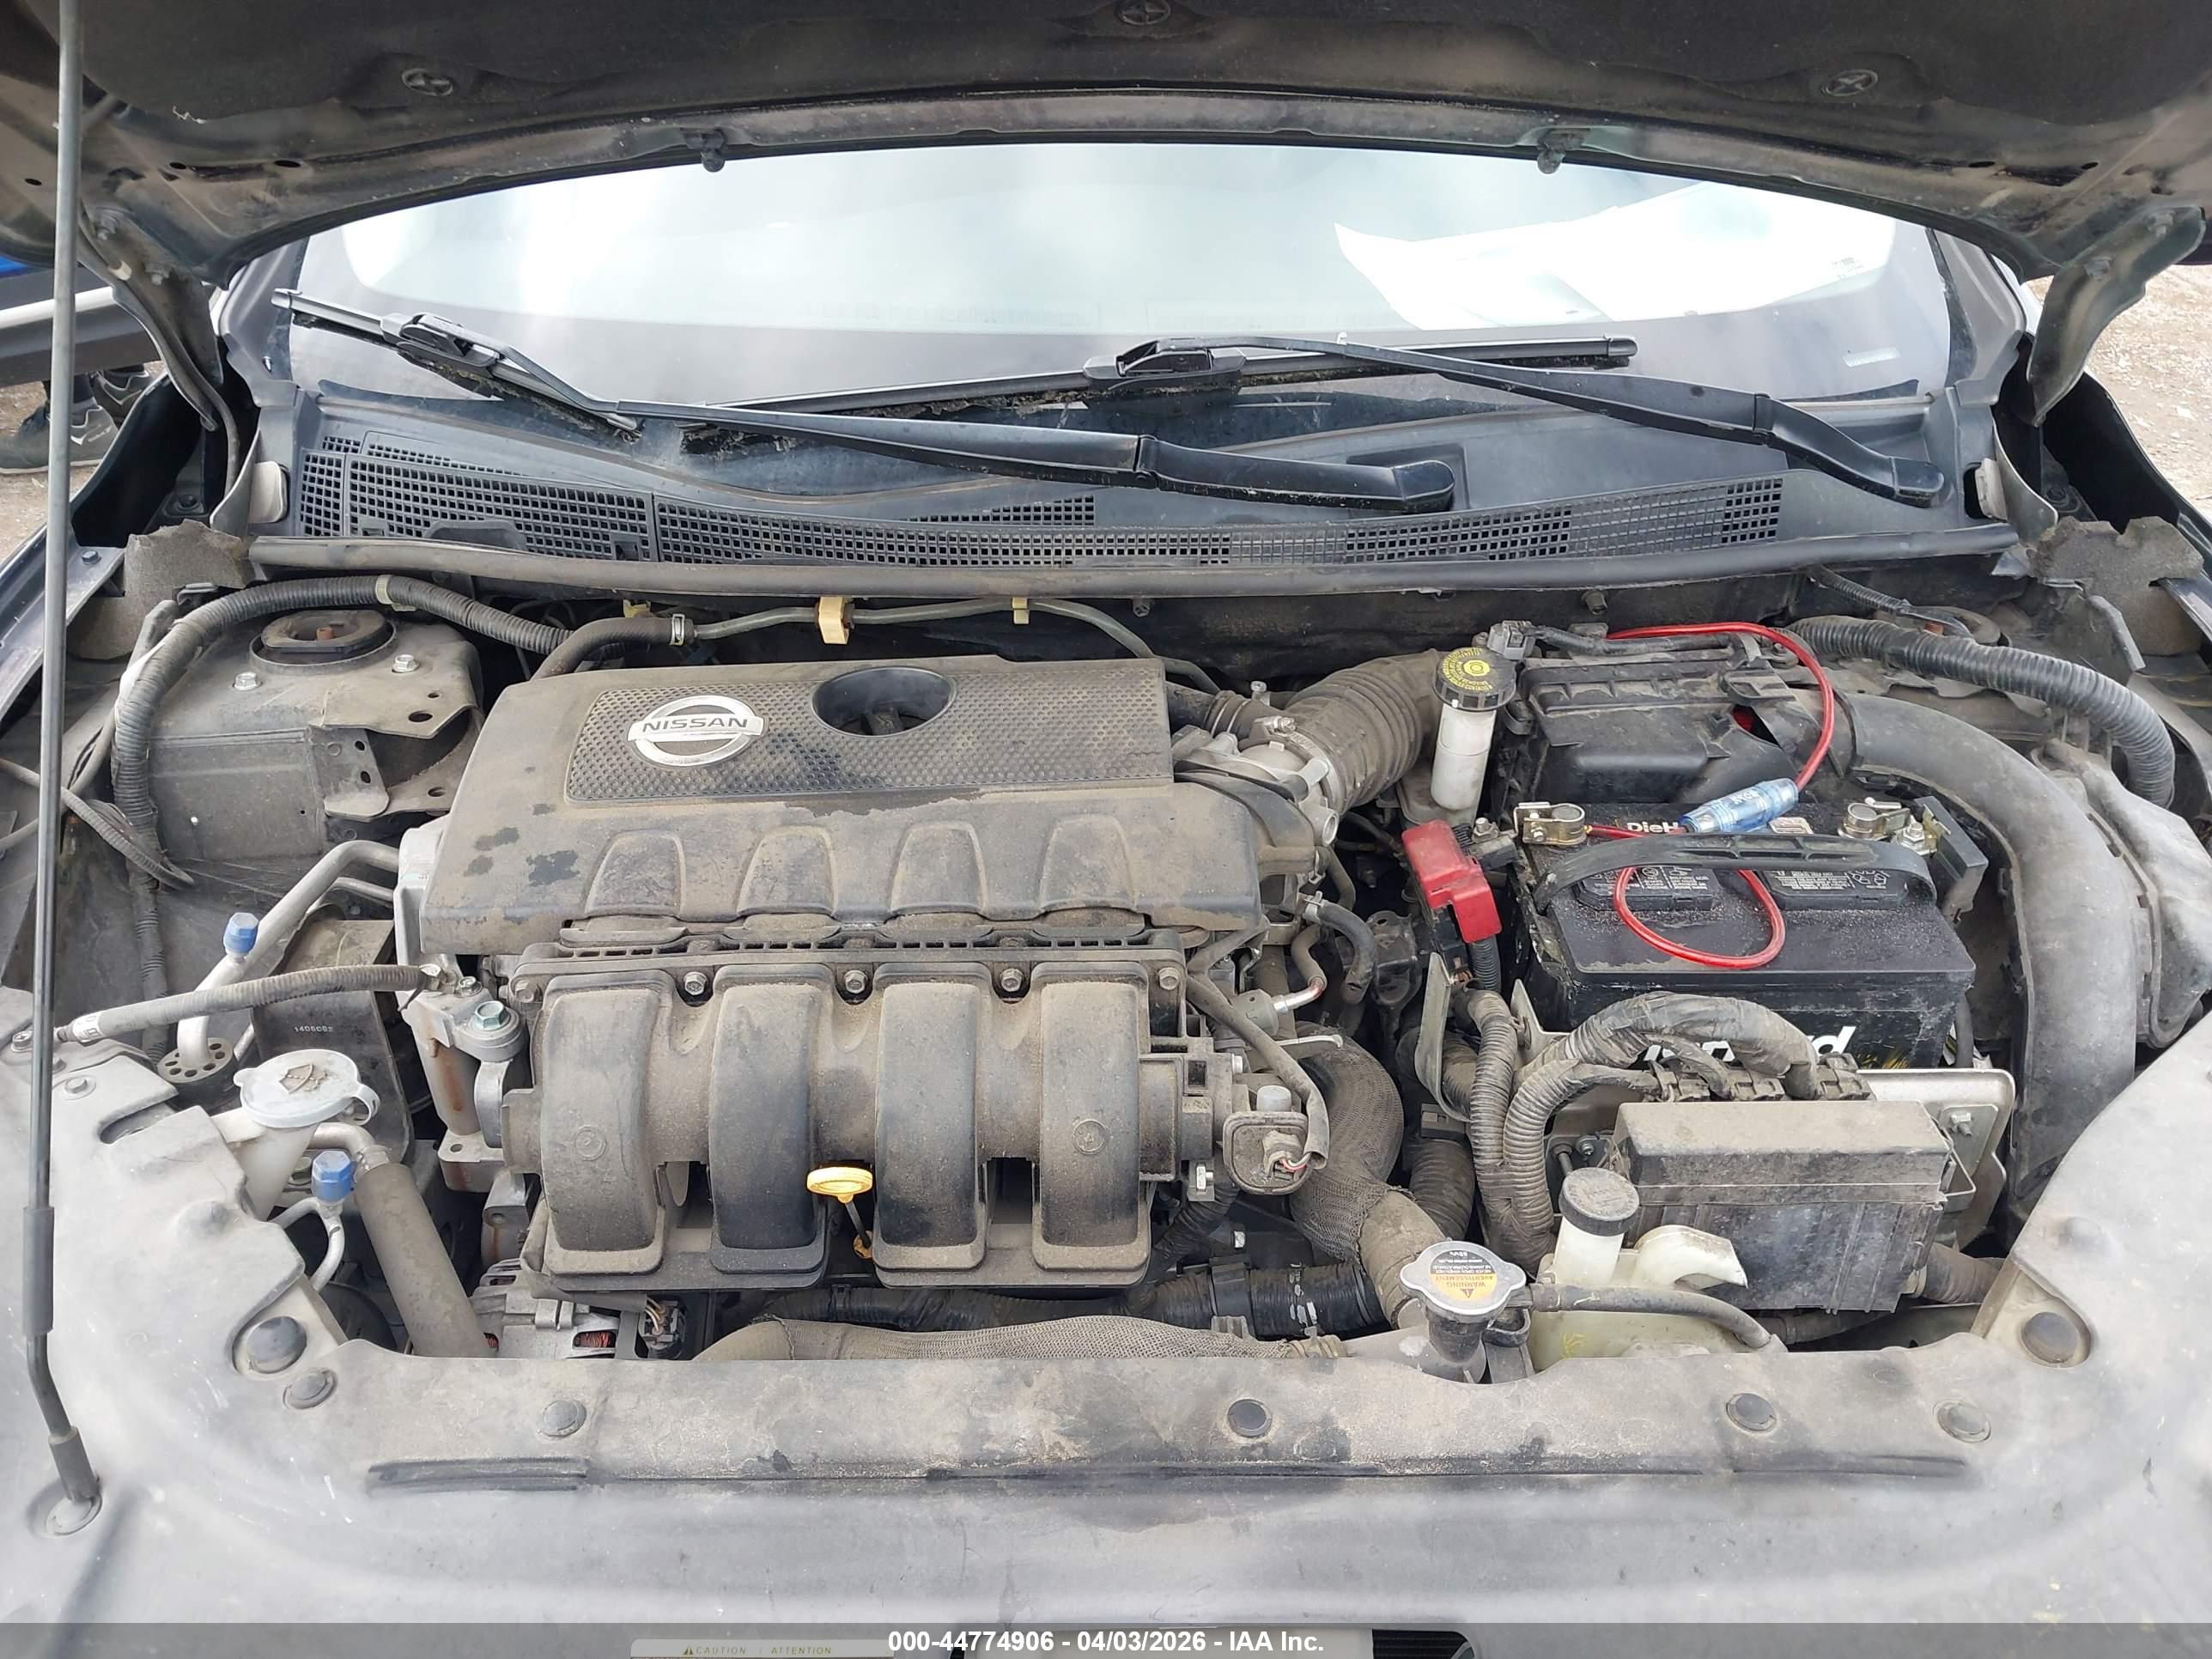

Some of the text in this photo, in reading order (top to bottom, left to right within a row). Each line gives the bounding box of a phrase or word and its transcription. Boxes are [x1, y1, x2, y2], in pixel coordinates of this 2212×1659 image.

[642, 717, 748, 732] NISSAN
[696, 1646, 747, 1655] CAUTION
[771, 1645, 832, 1655] ATTENTION
